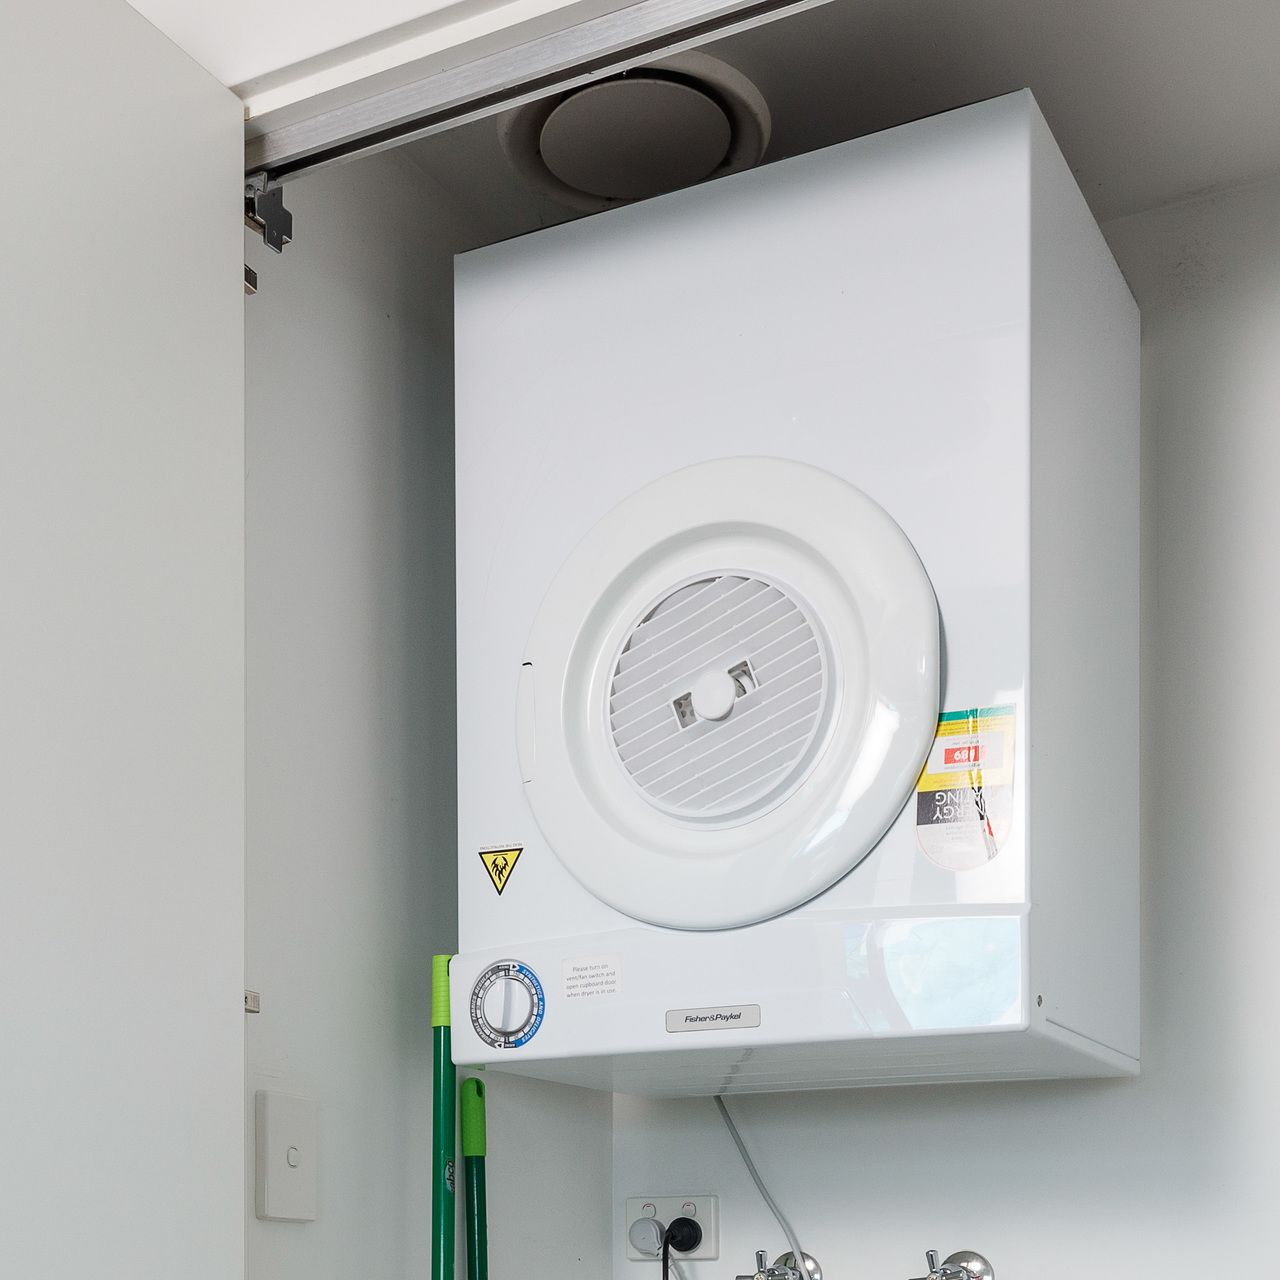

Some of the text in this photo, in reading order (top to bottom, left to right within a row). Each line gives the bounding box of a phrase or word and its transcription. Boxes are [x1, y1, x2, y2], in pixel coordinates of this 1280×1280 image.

[475, 970, 492, 994] REGULAR
[522, 968, 542, 998] SYNTHETICS
[580, 980, 604, 989] cupboard
[474, 1020, 492, 1042] DURABLE
[522, 1016, 540, 1042] DELICATES
